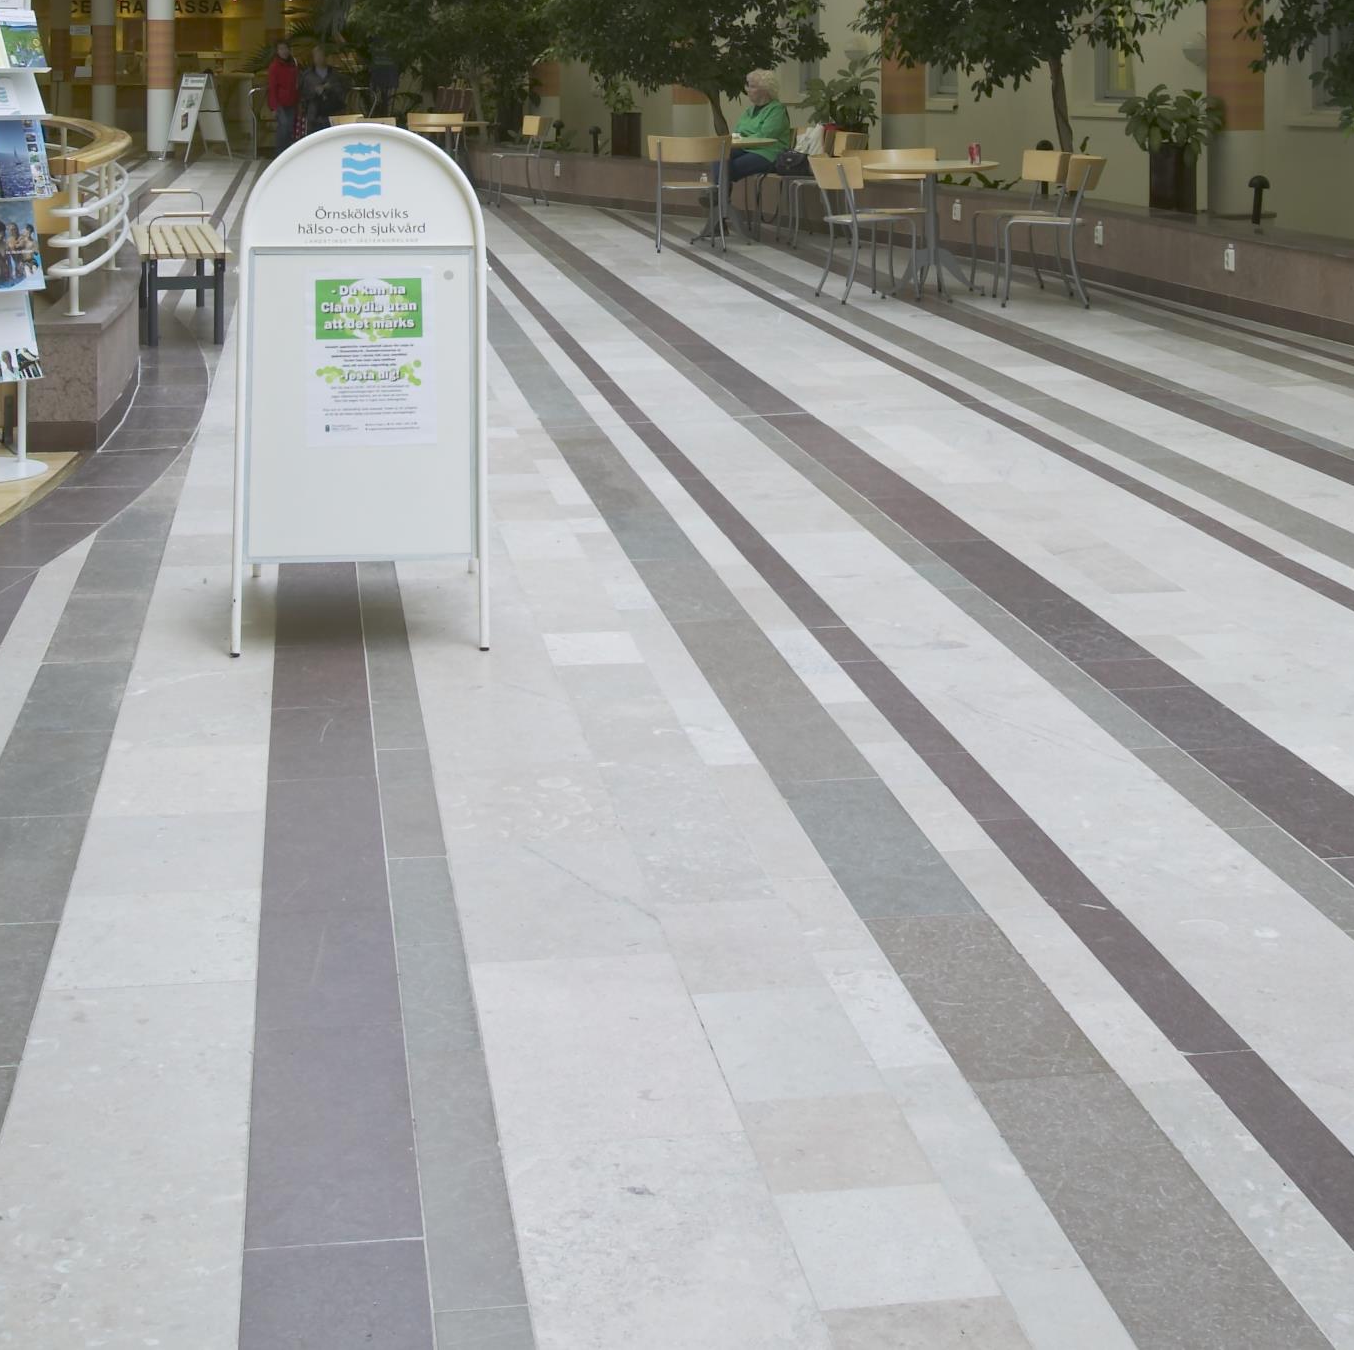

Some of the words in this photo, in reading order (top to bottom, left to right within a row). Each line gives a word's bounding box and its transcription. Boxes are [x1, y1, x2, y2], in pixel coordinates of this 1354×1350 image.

[70, 0, 223, 15] CERAASSA
[315, 206, 409, 220] Örnsköldsviks
[298, 223, 365, 235] hälso-och
[370, 223, 426, 236] sjukvård
[339, 285, 358, 296] Du
[361, 285, 387, 296] kan
[389, 284, 406, 296] ha
[321, 302, 385, 315] Clamydia
[388, 301, 418, 312] utan
[324, 318, 344, 330] att
[346, 318, 370, 330] det
